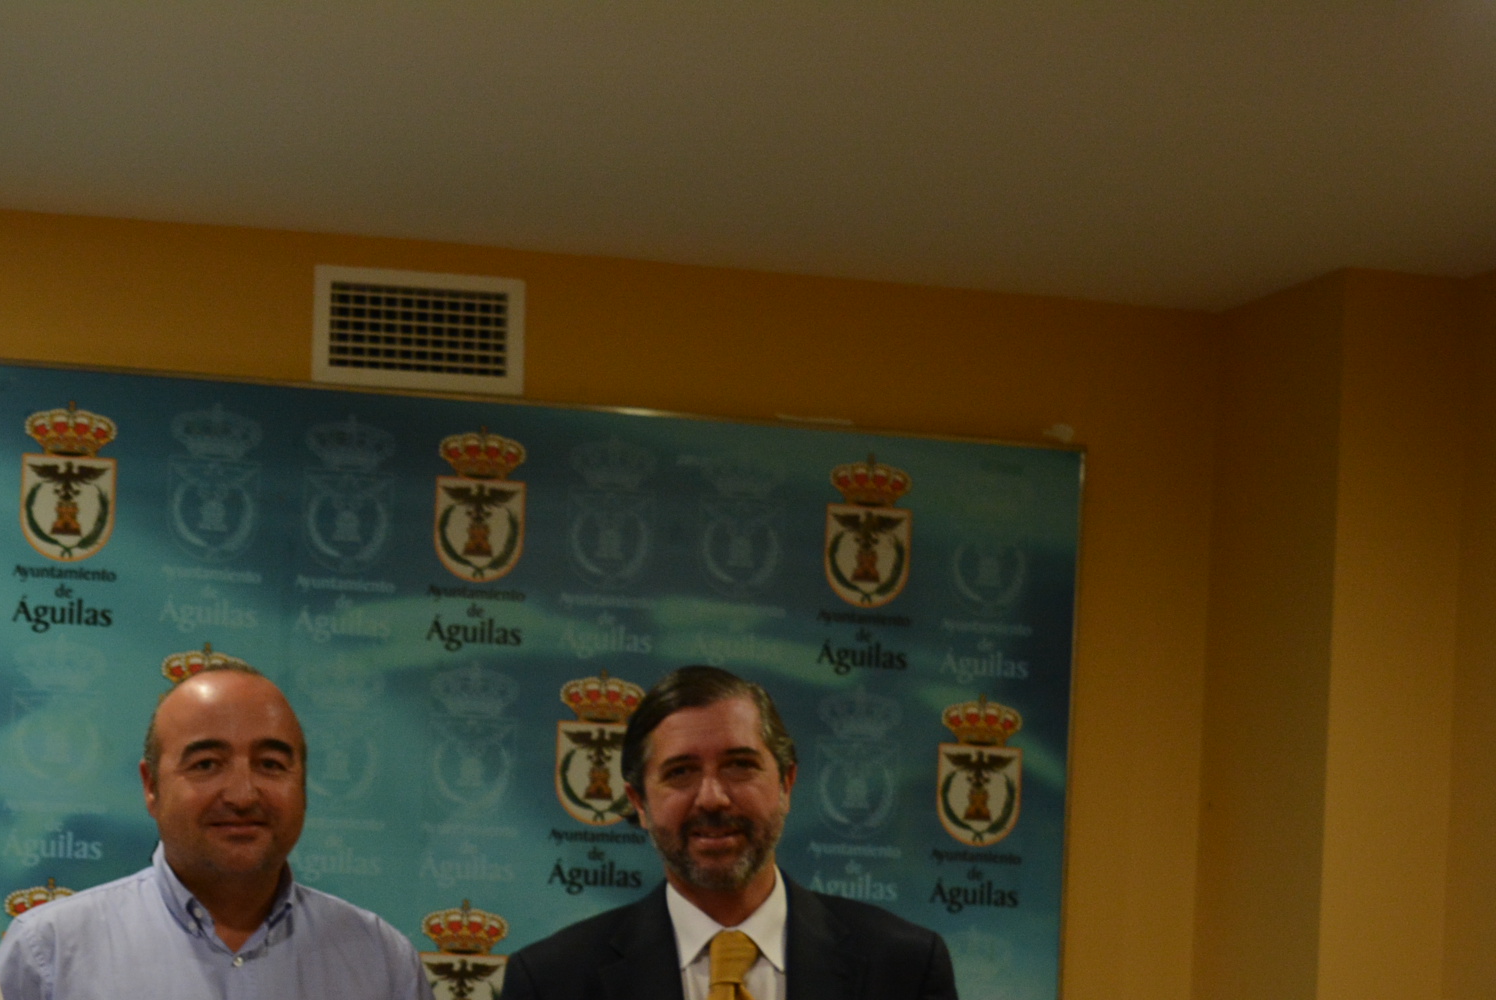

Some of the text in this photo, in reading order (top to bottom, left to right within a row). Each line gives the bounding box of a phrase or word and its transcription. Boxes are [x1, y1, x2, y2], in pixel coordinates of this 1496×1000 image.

[12, 564, 117, 583] Ayuntamiento
[55, 584, 74, 599] de
[426, 584, 528, 602] Ayuntamiento
[11, 594, 115, 634] Águilas
[159, 593, 260, 632] Águilas
[467, 603, 485, 618] de
[816, 611, 913, 628] Ayuntamiento
[292, 605, 392, 643] Águilas
[425, 613, 524, 652] Águilas
[855, 628, 873, 642] de
[559, 620, 653, 660] Águilas
[817, 636, 909, 675] Águilas
[939, 648, 1029, 684] Águilas
[2, 829, 104, 867] Águilas
[547, 827, 646, 846] Ayuntamiento
[806, 839, 902, 859] Ayuntamiento
[587, 846, 605, 860] de
[928, 848, 1023, 866] Ayuntamiento
[419, 850, 517, 889] Águilas
[546, 858, 643, 895] Águilas
[844, 859, 862, 874] de
[967, 866, 984, 881] de
[809, 870, 898, 900] Águilas
[928, 876, 1020, 915] Águilas
